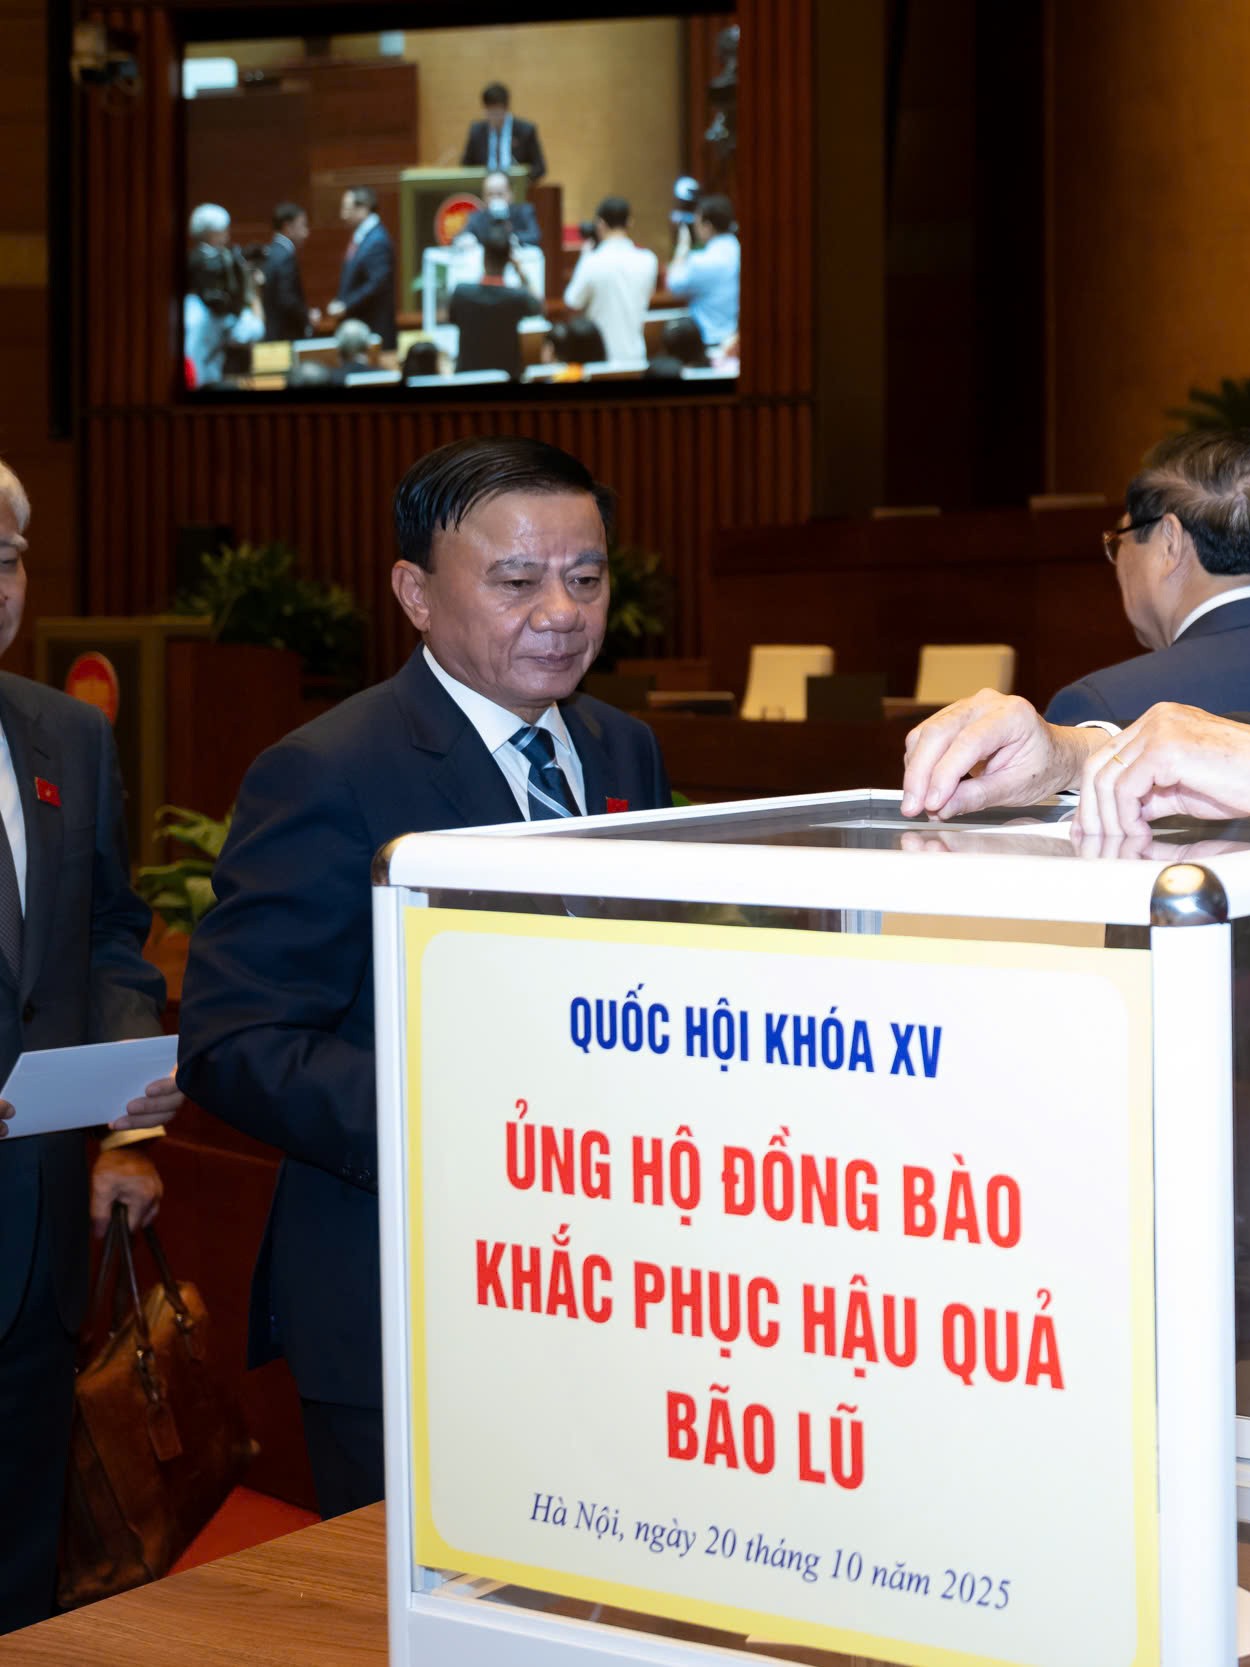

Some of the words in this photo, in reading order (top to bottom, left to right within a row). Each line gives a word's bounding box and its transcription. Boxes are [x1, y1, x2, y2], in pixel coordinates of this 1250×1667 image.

[569, 983, 671, 1055] QUỐC
[684, 996, 750, 1073] HỘI
[764, 1005, 875, 1073] KHÓA
[889, 1022, 943, 1079] XV
[505, 1098, 612, 1201] ỦNG
[631, 1124, 701, 1227] HỘ
[720, 1125, 879, 1233] ĐỒNG
[902, 1153, 1022, 1249] BÀO
[475, 1223, 613, 1324] KHẮC
[633, 1260, 781, 1359] PHỤC
[802, 1273, 918, 1379] HẬU
[941, 1287, 1065, 1391] QUẢ
[666, 1382, 776, 1476] BÃO
[797, 1402, 865, 1492] LŨ
[529, 1492, 568, 1527] Hà
[574, 1500, 625, 1542] Nội,
[634, 1517, 697, 1558] ngày
[704, 1525, 737, 1559] 20
[745, 1533, 821, 1583] tháng
[831, 1548, 864, 1582] 10
[871, 1562, 931, 1596] năm
[940, 1568, 1011, 1611] 2025
